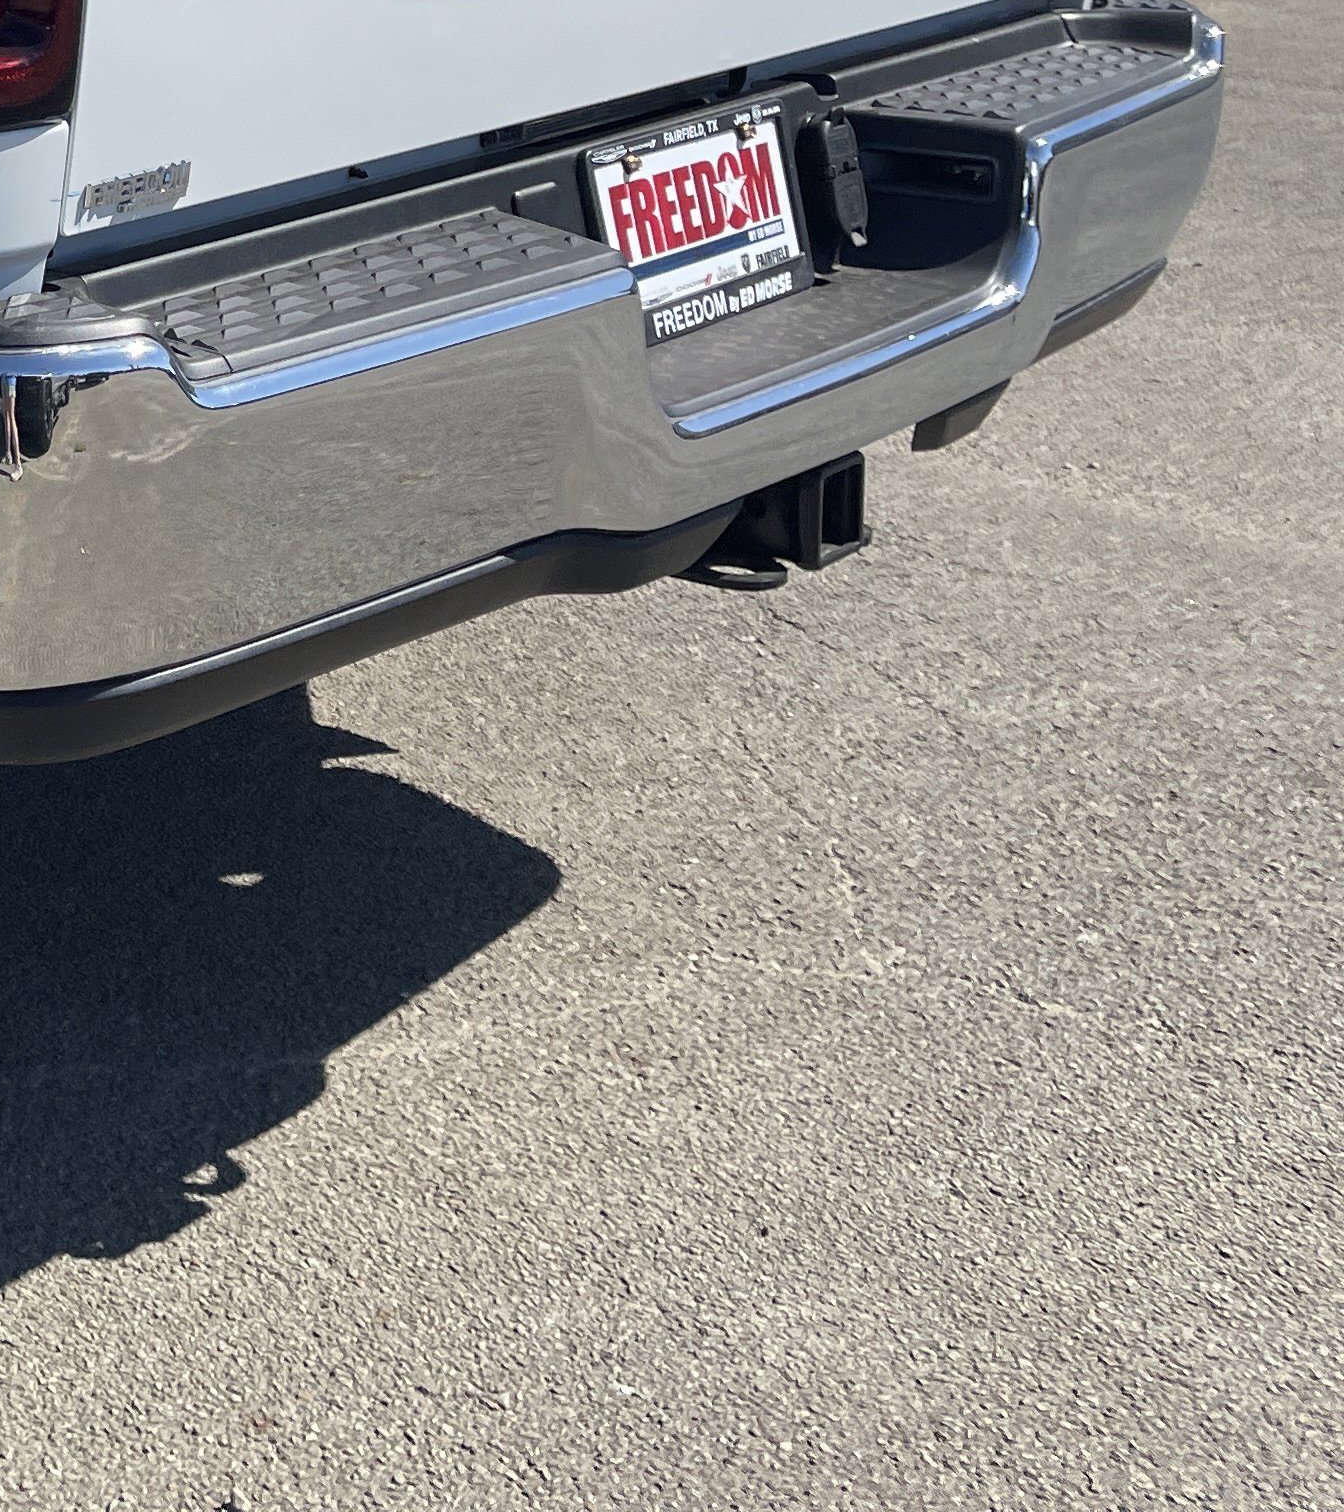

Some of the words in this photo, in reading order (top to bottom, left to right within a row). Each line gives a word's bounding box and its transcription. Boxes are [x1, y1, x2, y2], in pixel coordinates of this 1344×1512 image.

[663, 122, 707, 146] FAIRFIELD,
[705, 119, 719, 134] TX
[608, 141, 782, 264] FREEDOM
[652, 289, 729, 339] FREEDOM
[739, 285, 755, 308] ED
[754, 271, 793, 303] MORSE
